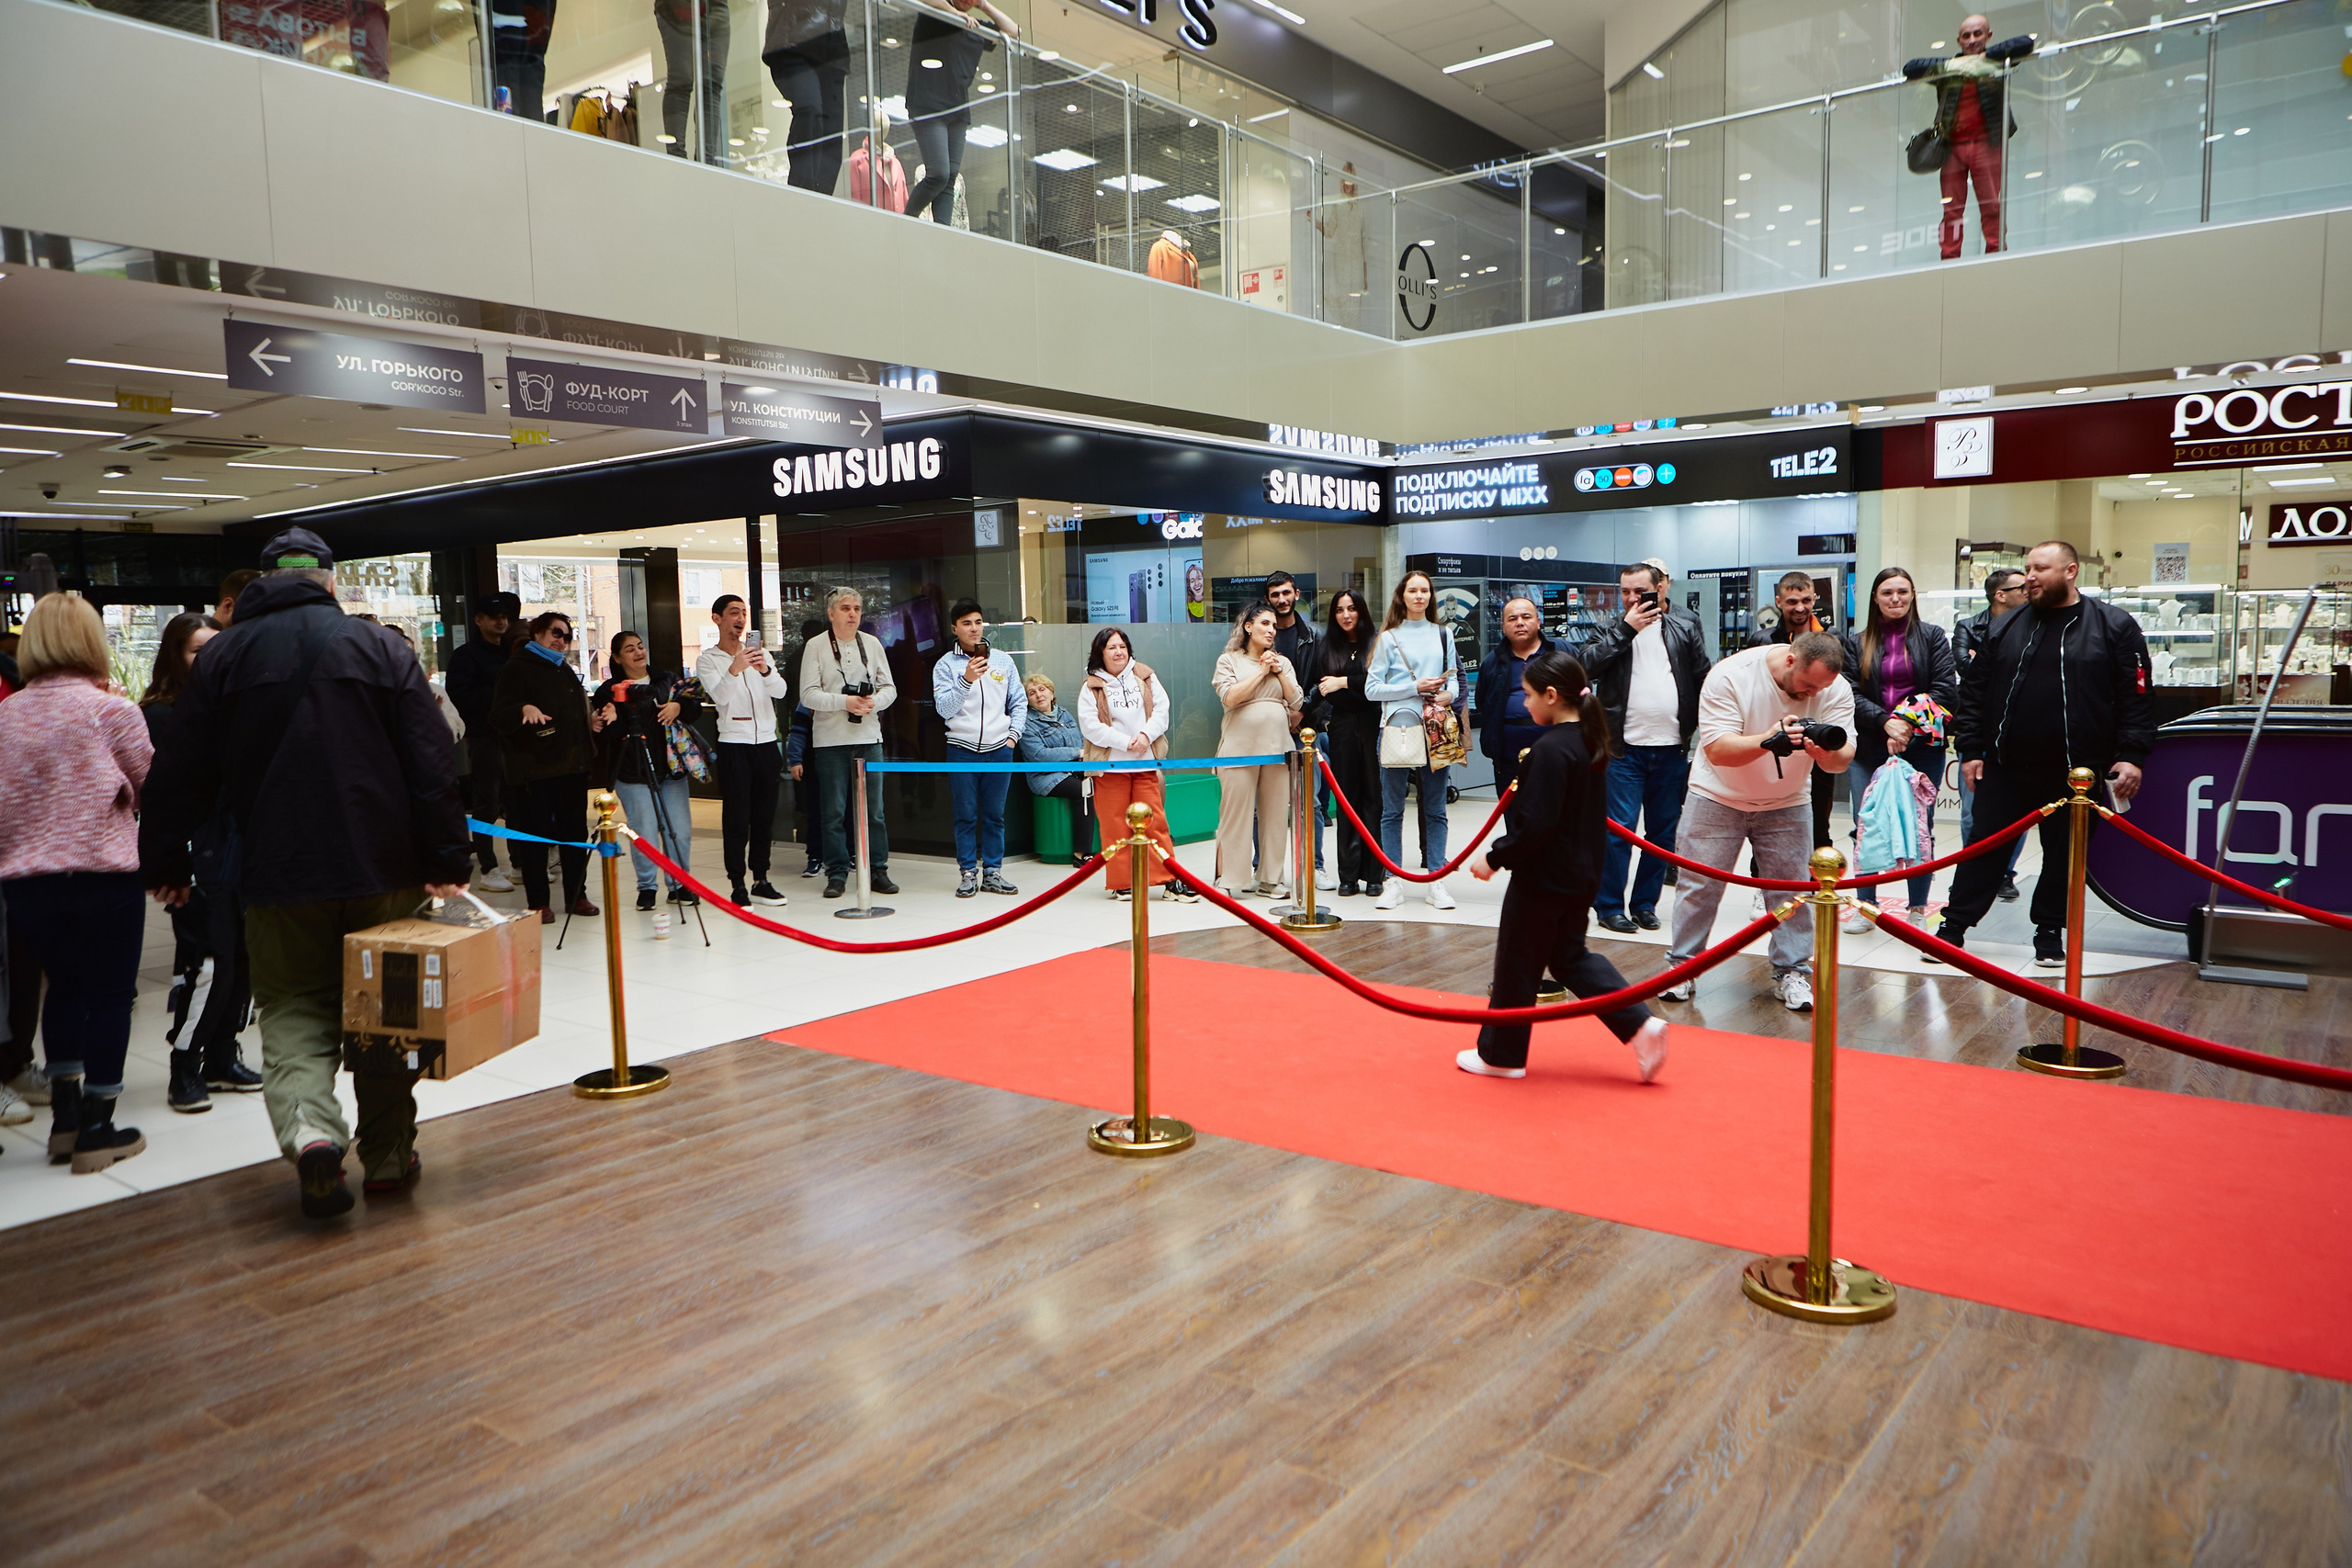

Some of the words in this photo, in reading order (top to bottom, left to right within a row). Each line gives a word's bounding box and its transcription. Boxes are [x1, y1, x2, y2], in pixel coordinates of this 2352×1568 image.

[1398, 276, 1437, 300] OLLI'S
[336, 355, 368, 372] УЛ.
[371, 358, 463, 383] ГОРЬКОГО
[391, 380, 447, 396] GOR'KOGO
[448, 388, 465, 398] Str.
[565, 381, 650, 402] ФУД-КОРТ
[567, 400, 595, 412] FOOD
[597, 403, 629, 414] COURT
[730, 400, 751, 413] УЛ.
[753, 403, 841, 423] КОНСТИТУЦИИ
[2170, 380, 2352, 439] РОСТ
[731, 416, 778, 429] KONSTITUTSII
[778, 422, 790, 430] Str.
[2175, 437, 2349, 460] РОССИЙСКАЯ
[773, 437, 941, 497] SAMSUNG
[1770, 446, 1838, 479] TELE2
[1395, 462, 1540, 494] ПОДКЛЮЧАЙТЕ
[1270, 469, 1380, 513] SAMSUNG
[1396, 491, 1497, 515] ПОДПИСКУ
[2271, 506, 2352, 539] ЛО
